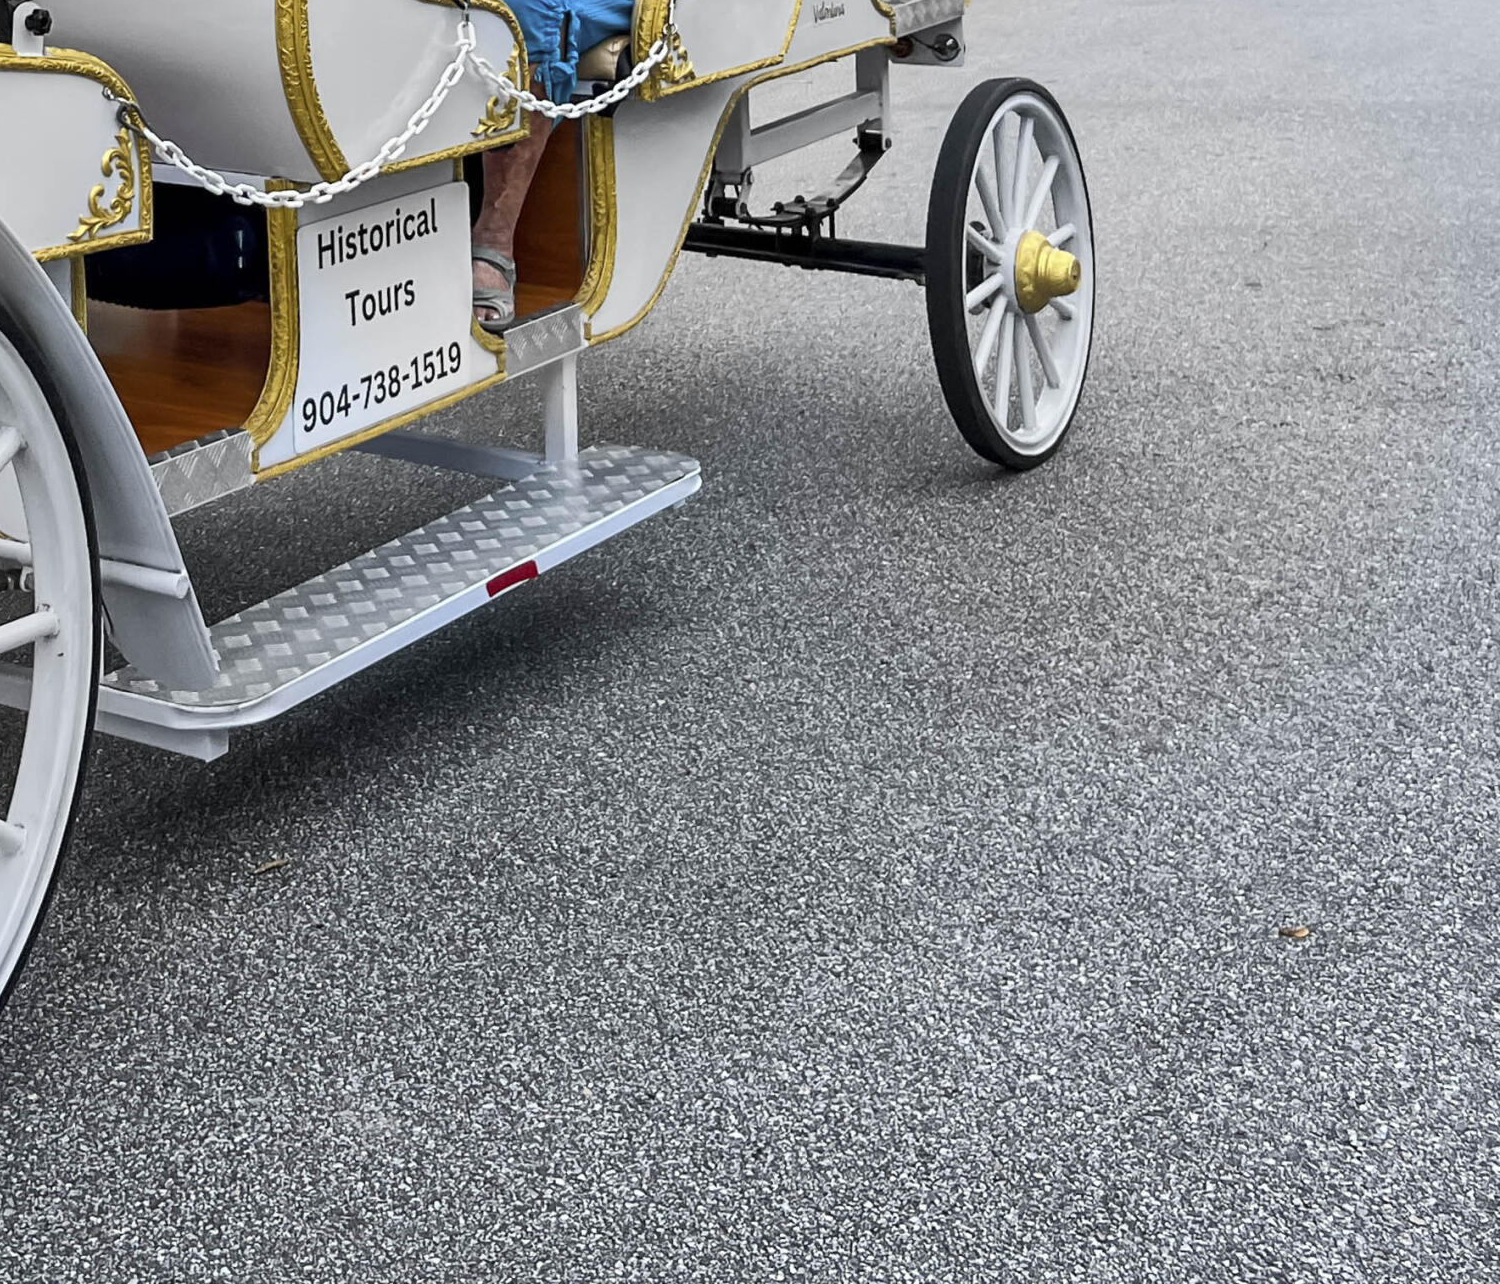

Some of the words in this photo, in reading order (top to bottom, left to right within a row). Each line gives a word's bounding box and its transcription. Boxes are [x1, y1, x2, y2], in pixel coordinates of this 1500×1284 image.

[317, 197, 438, 269] Historical
[345, 278, 416, 326] Tours
[302, 341, 462, 433] 904-738-1519
